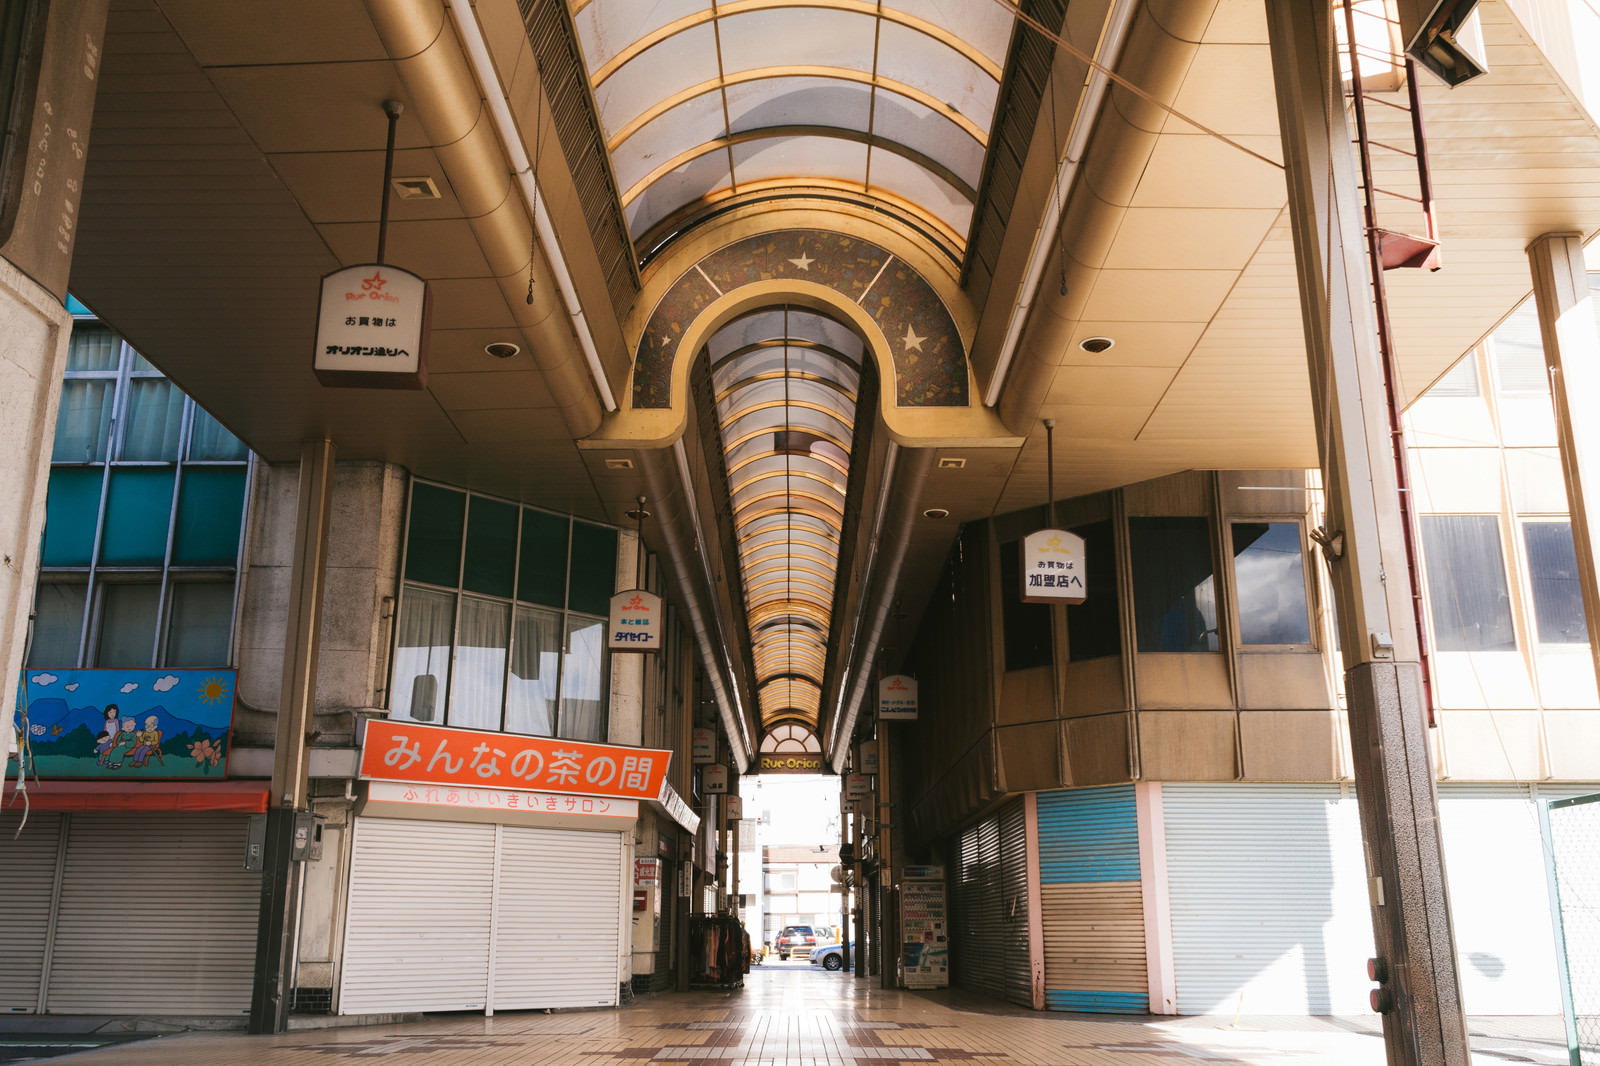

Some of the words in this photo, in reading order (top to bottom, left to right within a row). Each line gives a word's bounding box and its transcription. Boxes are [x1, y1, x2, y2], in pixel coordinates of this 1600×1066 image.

[345, 316, 396, 328] お買物は
[325, 345, 410, 357] オリオン通りへ
[1037, 561, 1073, 570] お買物は
[1029, 574, 1083, 588] 加盟店へ
[383, 735, 653, 792] みんなの茶の間
[761, 757, 785, 769] Rue
[786, 757, 821, 769] Orion
[402, 784, 612, 813] ふれあいいきいきサロン
